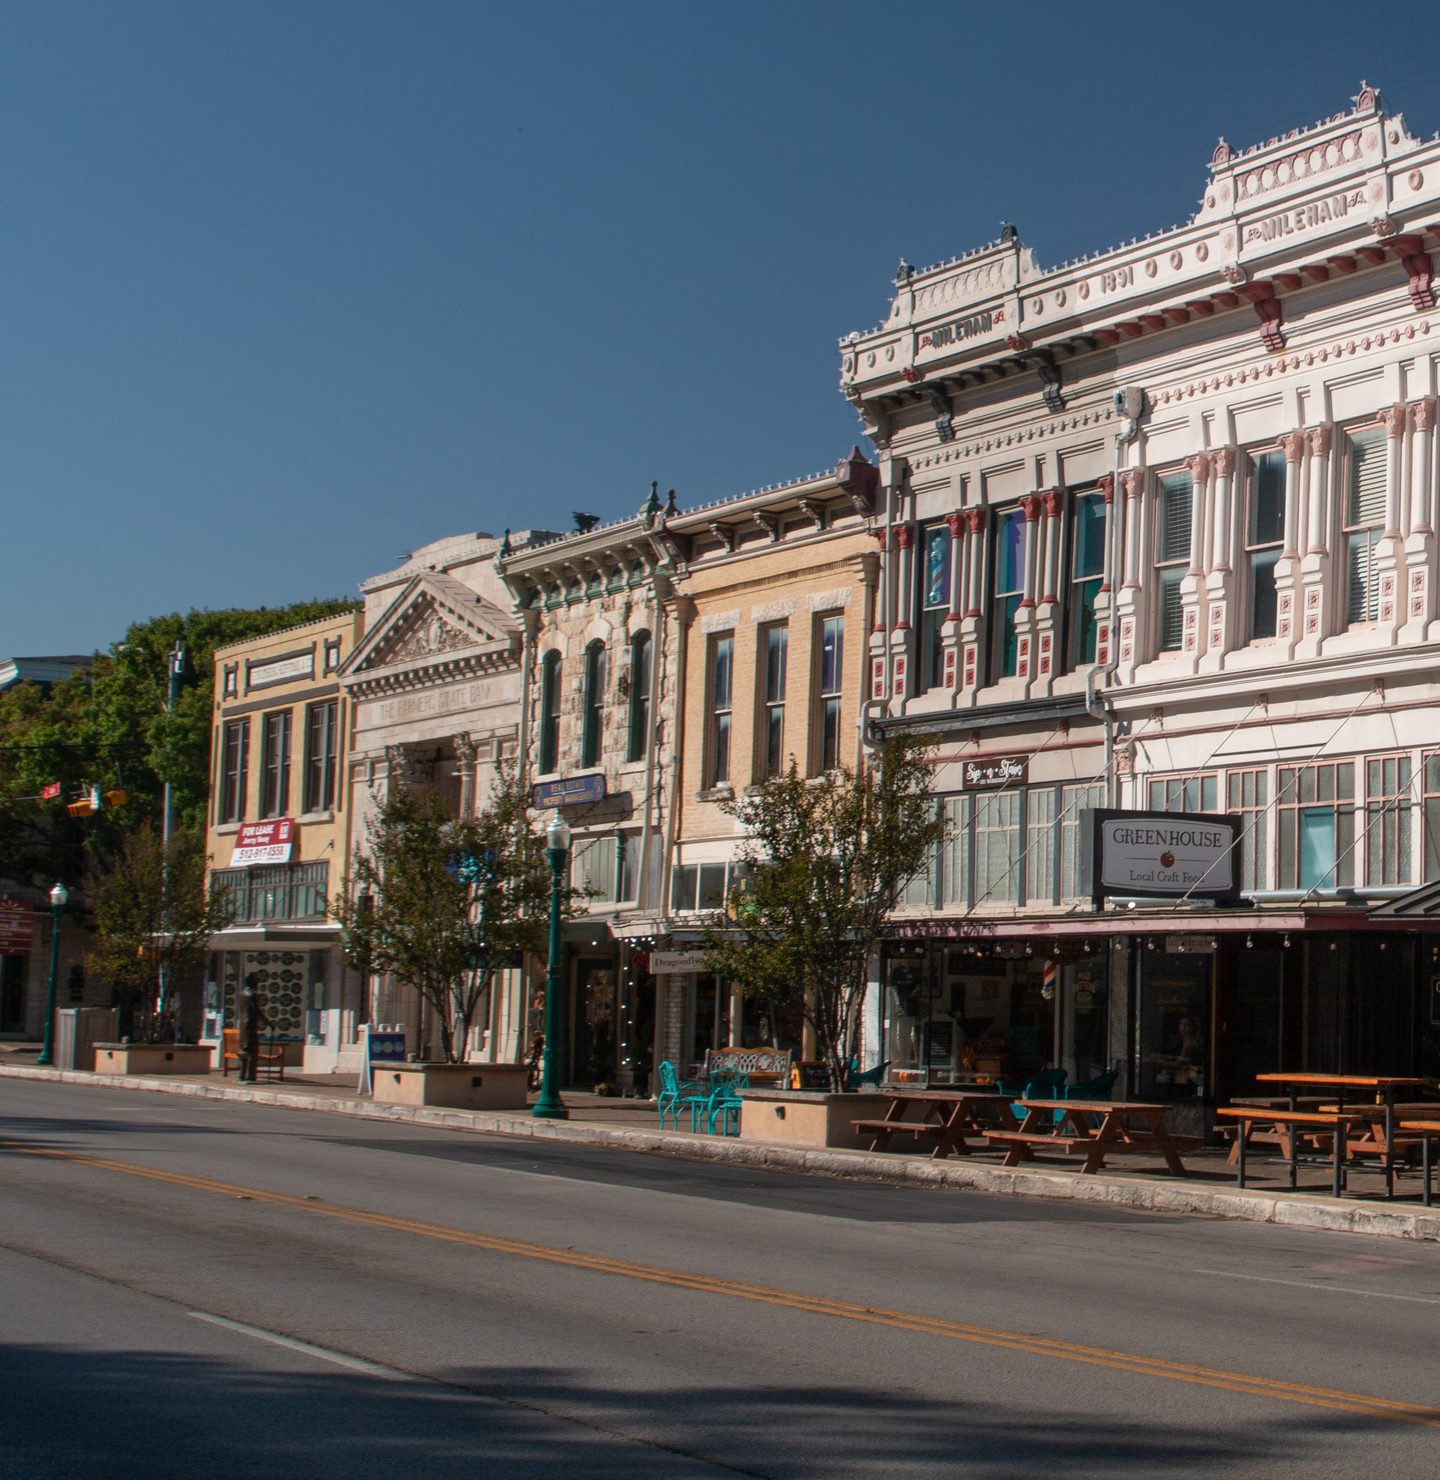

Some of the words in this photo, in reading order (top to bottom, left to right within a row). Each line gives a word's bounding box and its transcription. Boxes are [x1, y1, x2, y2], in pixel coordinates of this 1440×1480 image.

[1261, 194, 1348, 242] MILEHAM
[1101, 266, 1134, 294] 1891
[932, 312, 993, 349] MILEHAM
[439, 687, 468, 709] STATE
[242, 826, 255, 836] FOR
[255, 824, 275, 835] LEASE
[1112, 828, 1222, 848] GREENHOUSE
[1130, 869, 1154, 882] Local
[1157, 870, 1179, 883] Craft
[1182, 872, 1204, 883] Food
